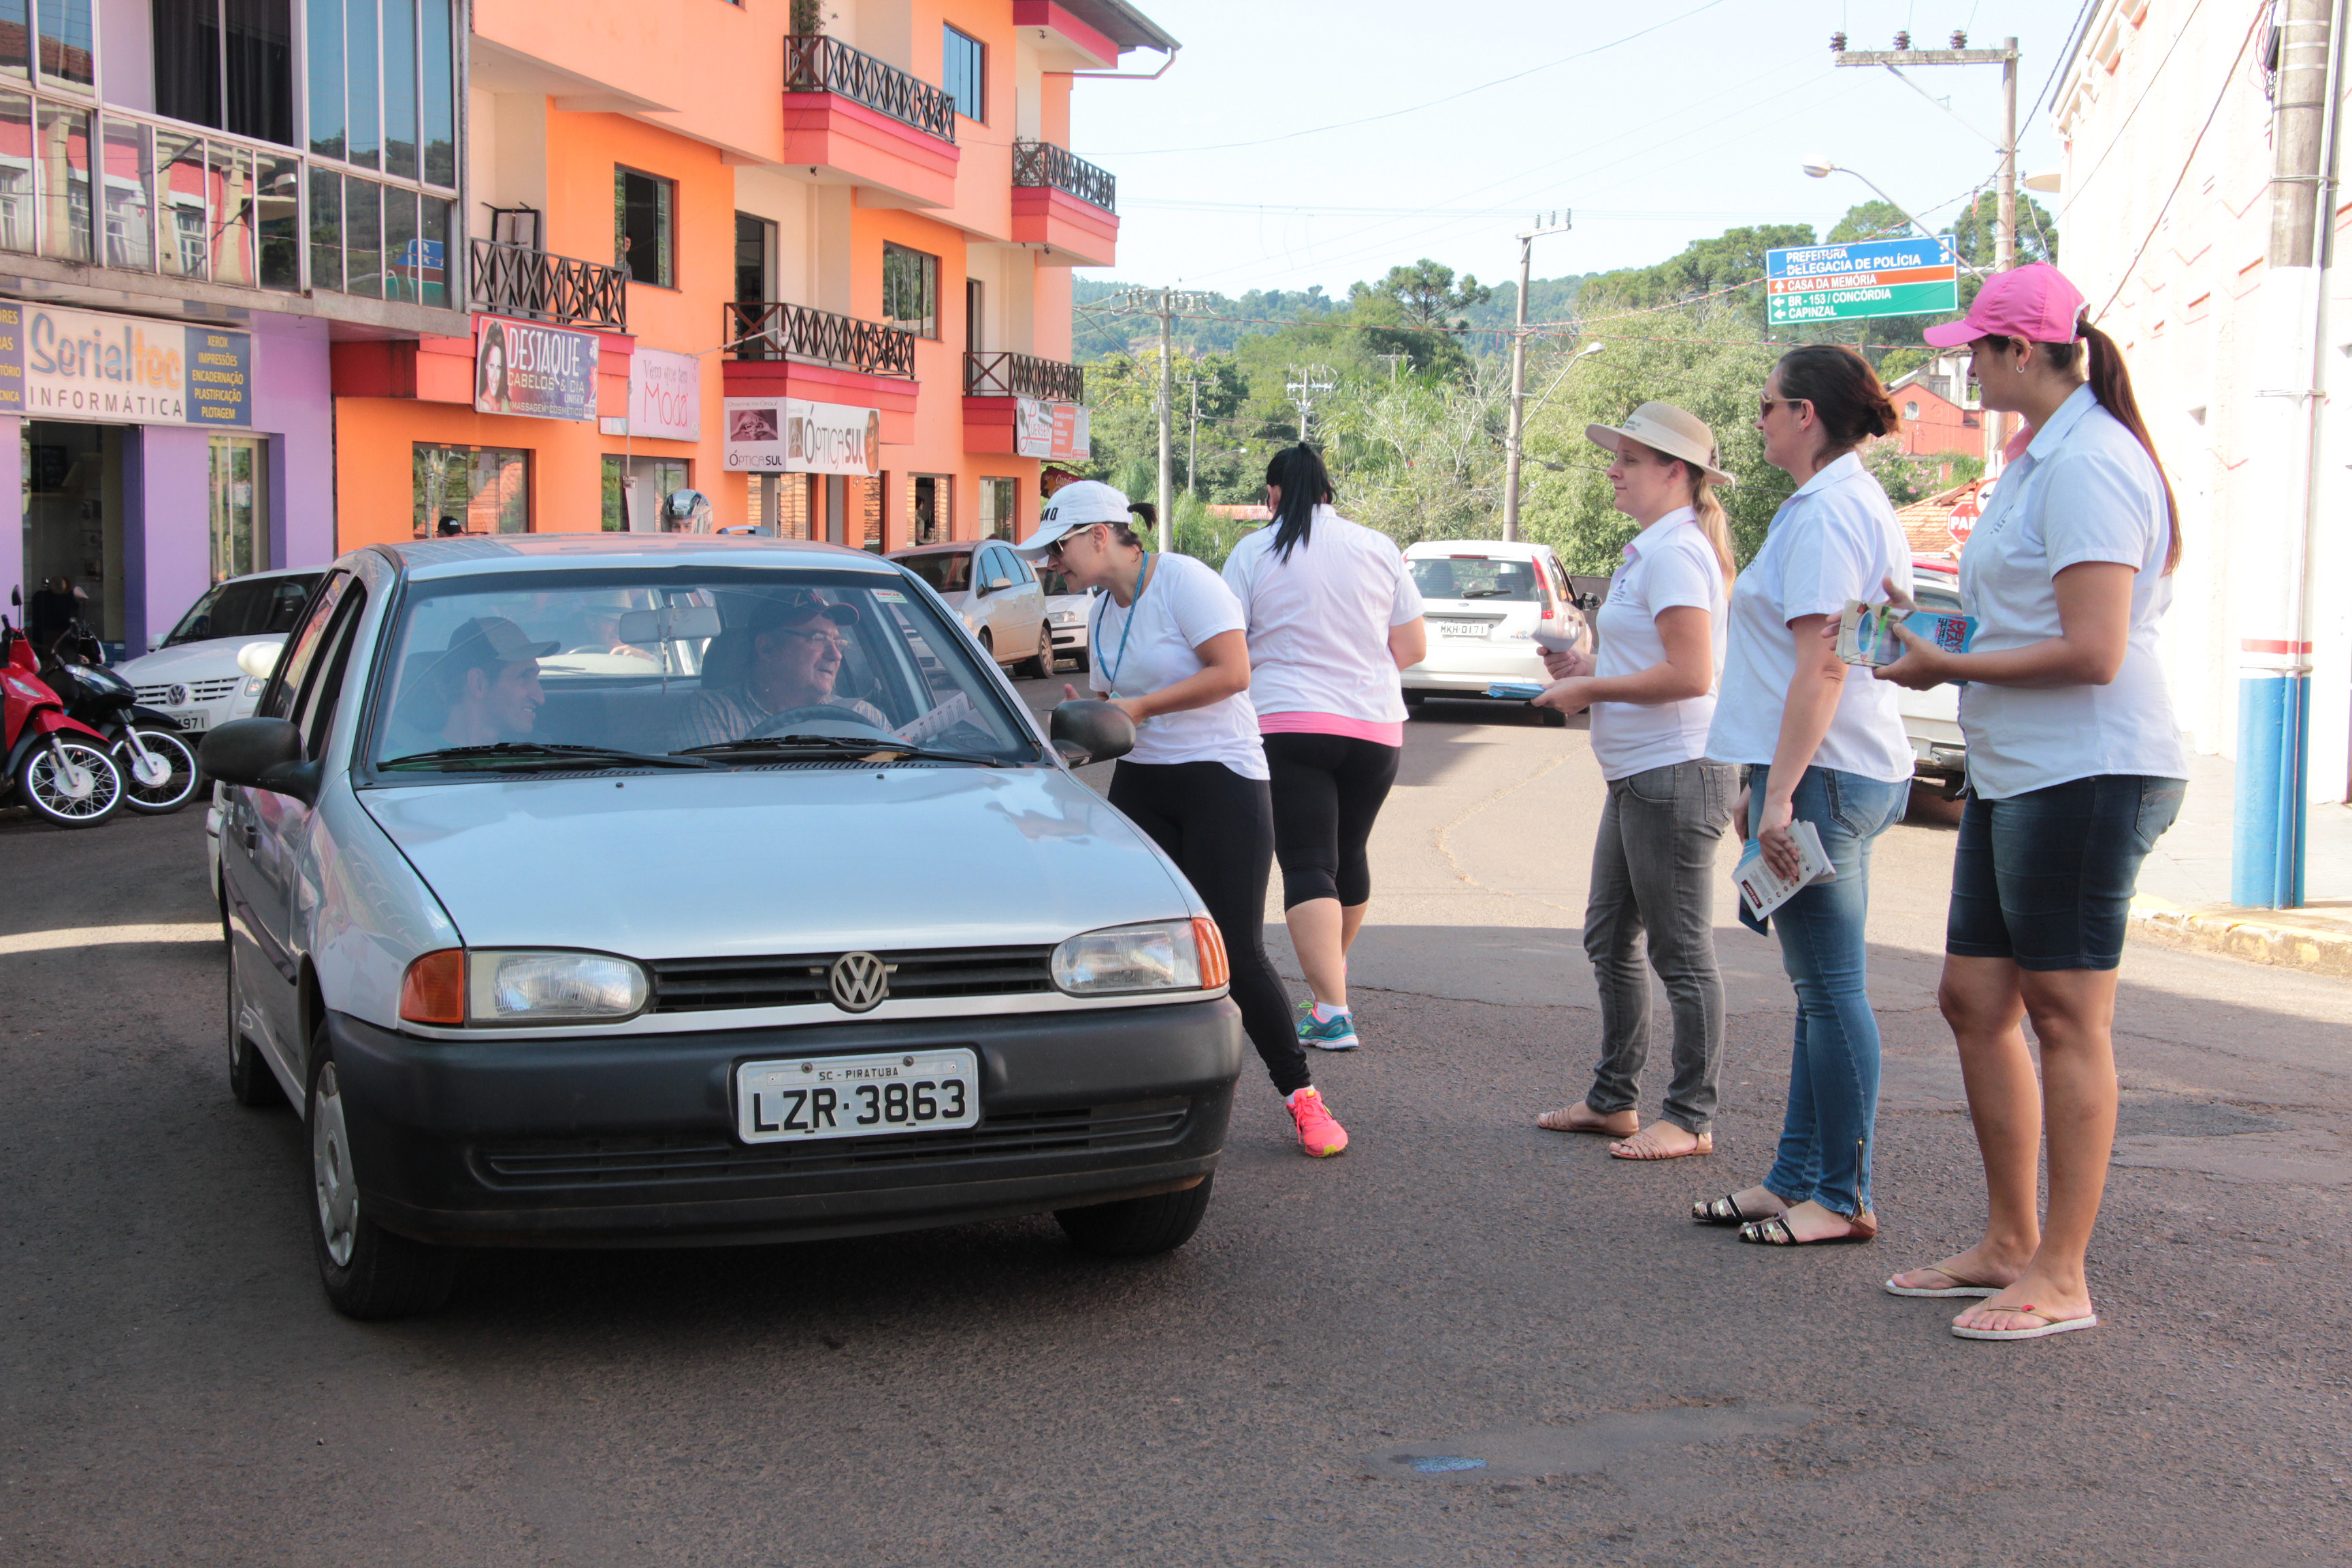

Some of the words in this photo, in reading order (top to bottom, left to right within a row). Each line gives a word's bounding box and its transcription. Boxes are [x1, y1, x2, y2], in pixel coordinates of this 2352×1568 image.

[1786, 248, 1848, 263] PREFEITURA
[1786, 261, 1853, 276] DELEGACIA
[1855, 258, 1872, 270] DE
[1874, 253, 1921, 268] POLÍCIA
[1787, 280, 1814, 291] CASA
[1816, 278, 1830, 289] DA
[1831, 274, 1877, 287] MEMÓRIA
[1832, 288, 1892, 304] CONCÓRDIA
[1788, 306, 1838, 318] CAPINZAL
[207, 335, 229, 348] XEROX
[198, 352, 238, 367] IMPRESSÕES
[508, 327, 581, 386] DESTAQUE
[192, 370, 244, 387] ENCADERNAÇÃO
[507, 372, 555, 391] CABELOS
[560, 379, 566, 391] &
[570, 380, 585, 393] CIA
[30, 386, 182, 417] INFORMÁTICA
[194, 387, 242, 404] PLASTIFICAÇÃO
[564, 393, 584, 404] UNISEX
[201, 406, 235, 419] PLOTAGEM
[1950, 516, 1978, 529] PAR
[846, 1066, 899, 1079] PIRATUBA
